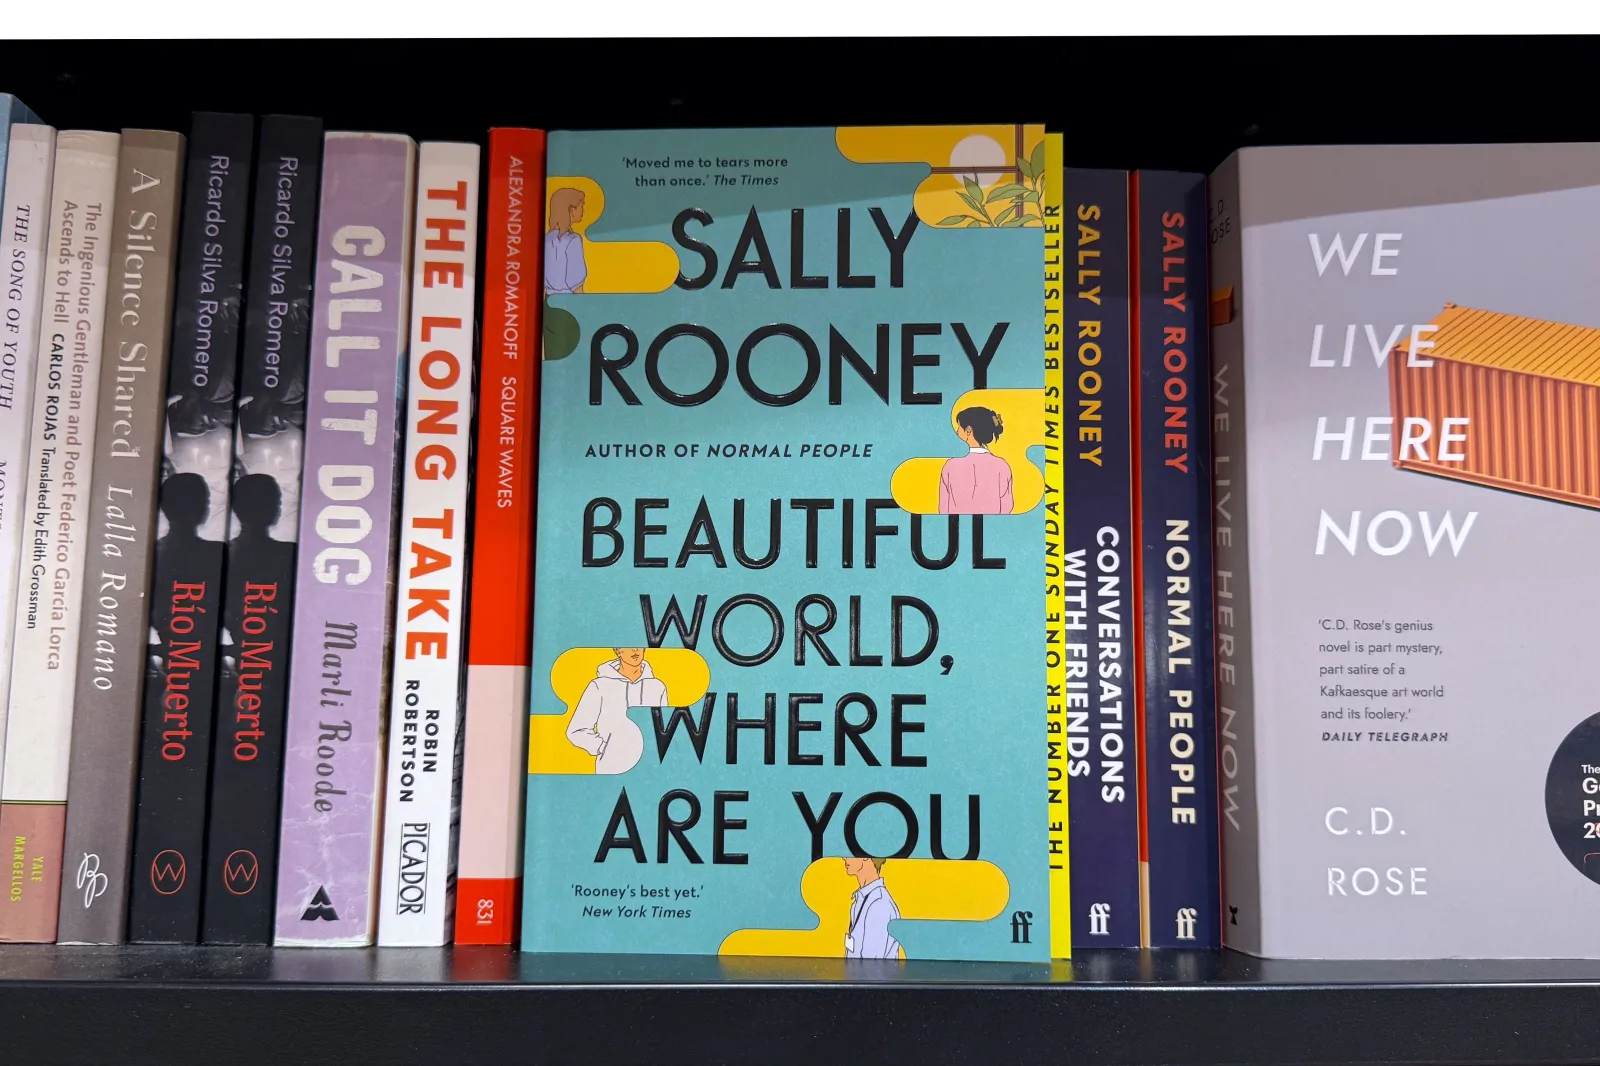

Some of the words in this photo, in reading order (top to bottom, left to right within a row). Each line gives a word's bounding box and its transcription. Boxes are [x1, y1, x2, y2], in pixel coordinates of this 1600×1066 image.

[131, 167, 161, 194] A
[205, 155, 230, 237] Ricardo
[622, 156, 670, 169] 'Moved
[674, 158, 694, 168] me
[698, 157, 712, 168] to
[716, 157, 750, 168] tears
[753, 158, 788, 168] more
[635, 175, 666, 187] than
[669, 175, 710, 187] once.'
[714, 174, 737, 186] The
[741, 174, 779, 186] Times
[14, 204, 30, 242] THE
[85, 203, 102, 231] The
[275, 155, 299, 239] Ricardo
[505, 155, 524, 259] ALEXANDRA
[1211, 216, 1231, 244] OSE
[59, 200, 78, 265] Ascends
[422, 181, 468, 289] THE
[672, 205, 921, 291] SALLY
[1077, 204, 1102, 306] SALLY
[1162, 211, 1186, 313] SALLY
[1308, 232, 1403, 277] WE
[9, 250, 26, 301] SONG
[57, 270, 72, 286] to
[77, 236, 99, 315] Ingenious
[120, 210, 157, 327] Silence
[200, 242, 223, 294] Silva
[270, 244, 292, 295] Silva
[326, 225, 386, 368] CALL
[1044, 204, 1060, 369] BESTSELLER
[6, 308, 20, 333] OF
[53, 291, 70, 323] Hell
[503, 262, 520, 361] ROMANOFF
[0, 343, 18, 410] YOUTH
[48, 333, 64, 390] CARLOS
[70, 320, 91, 410] Gentleman
[194, 301, 218, 387] Romero
[264, 301, 289, 388] Romero
[589, 321, 1011, 407] ROONEY
[1309, 324, 1439, 369] LIVE
[43, 395, 59, 440] ROJAS
[110, 340, 148, 457] Shared
[320, 390, 379, 446] IT
[414, 316, 463, 482] LONG
[499, 376, 517, 446] SQUARE
[1078, 320, 1102, 467] ROONEY
[1163, 326, 1188, 474] ROONEY
[1213, 364, 1229, 433] WE
[66, 414, 83, 446] and
[585, 443, 667, 459] AUTHOR
[673, 443, 700, 458] OF
[707, 443, 793, 459] NORMAL
[800, 443, 873, 459] PEOPLE
[1312, 416, 1470, 462] HERE
[37, 447, 56, 509] Translated
[62, 451, 80, 486] Poet
[496, 447, 514, 509] WAVES
[1214, 455, 1232, 547] LIVE
[33, 511, 50, 527] by
[33, 529, 49, 562] Edith
[56, 491, 77, 563] Federico
[104, 484, 137, 558] Lalla
[312, 464, 375, 586] DOG
[581, 494, 1007, 570] BEAUTIFUL
[1045, 484, 1061, 596] SUNDAY
[1315, 509, 1478, 558] NOW
[27, 565, 46, 629] Grossman
[50, 568, 70, 622] García
[169, 580, 206, 634] Río
[242, 581, 279, 635] Río
[405, 508, 454, 660] TAKE
[1064, 548, 1087, 630] WITH
[1165, 520, 1192, 674] NORMAL
[47, 626, 65, 670] Lorca
[93, 570, 127, 691] Romano
[639, 593, 955, 675] WORLD,
[1046, 613, 1061, 668] ONE
[1216, 570, 1235, 686] HERE
[1318, 619, 1348, 631] 'C.D.
[1353, 619, 1390, 631] Rose's
[1394, 620, 1433, 634] genius
[1319, 640, 1350, 652] novel
[1355, 641, 1364, 652] is
[1368, 643, 1392, 655] part
[1395, 643, 1443, 655] mystery,
[319, 620, 359, 708] Marli
[1096, 526, 1125, 803] CONVERSATIONS
[1319, 665, 1344, 677] part
[1347, 664, 1379, 675] satire
[1382, 663, 1395, 675] of
[1398, 666, 1405, 675] a
[1320, 684, 1388, 700] Kafkaesque
[1391, 687, 1408, 697] art
[1411, 685, 1445, 697] world
[161, 640, 202, 761] Muerto
[233, 640, 274, 761] Muerto
[651, 692, 928, 768] WHERE
[1065, 643, 1091, 777] FRIENDS
[1320, 707, 1343, 719] and
[1347, 708, 1360, 719] its
[1364, 707, 1411, 722] foolery.'
[313, 720, 352, 813] Roode
[399, 680, 420, 802] ROBERTSON
[422, 709, 440, 773] ROBIN
[1047, 684, 1063, 804] NUMBER
[1169, 690, 1196, 825] PEOPLE
[1220, 706, 1240, 831] NOW
[1321, 731, 1362, 742] DAILY
[1368, 731, 1449, 742] TELEGRAPH
[1581, 764, 1600, 774] The
[1582, 777, 1600, 795] G
[593, 786, 749, 864] ARE
[792, 791, 980, 861] YOU
[1324, 806, 1407, 836] C.D.
[10, 836, 26, 903] MARGELLOS
[31, 856, 44, 883] YALE
[398, 822, 428, 915] PICADOR
[571, 884, 636, 900] 'Rooney's
[640, 885, 670, 898] best
[674, 885, 704, 901] yet.'
[1327, 866, 1429, 897] ROSE
[476, 898, 494, 926] 831
[582, 905, 613, 917] New
[617, 905, 647, 918] York
[651, 905, 692, 918] Times
